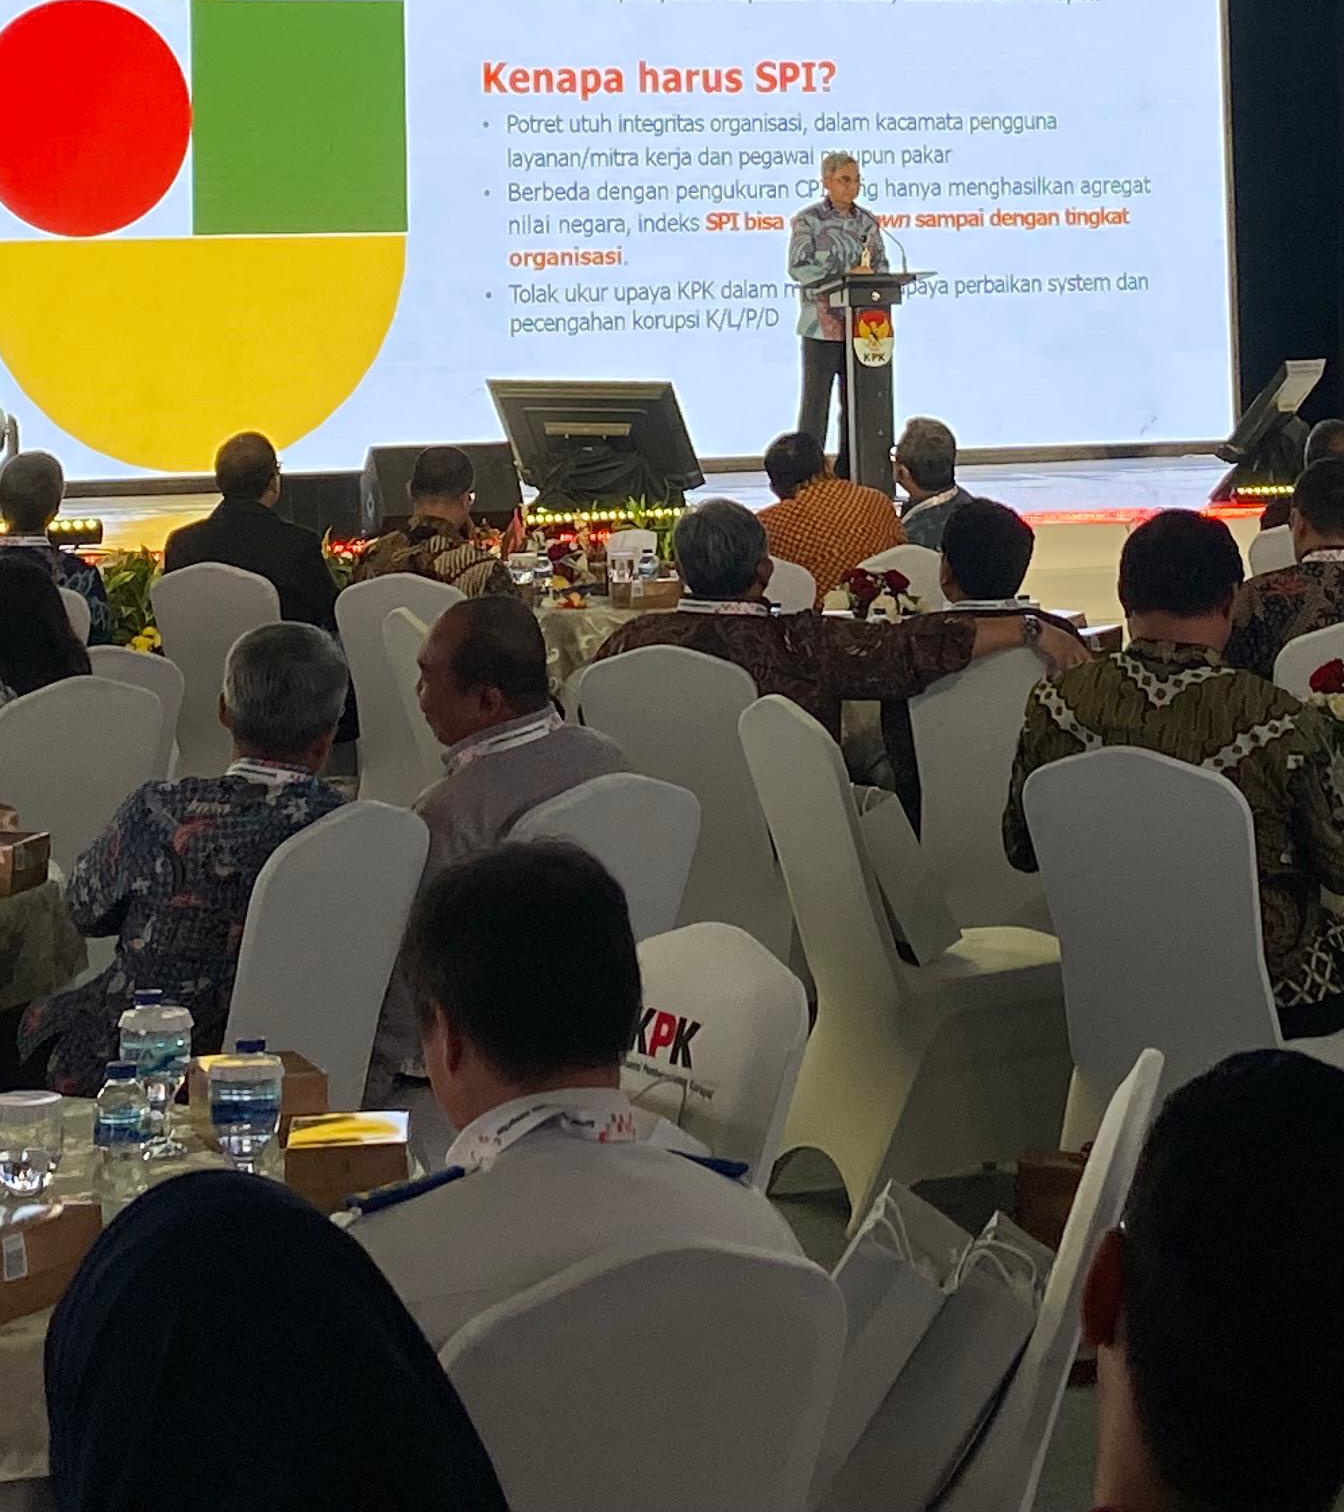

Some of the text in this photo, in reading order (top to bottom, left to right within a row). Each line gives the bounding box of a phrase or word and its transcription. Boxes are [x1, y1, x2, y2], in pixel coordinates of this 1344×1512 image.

[483, 61, 836, 101] Kenapa harus SPI?
[507, 113, 1057, 137] Potret utuh integritas organisasi, dalam kacamata pengguna
[507, 147, 639, 171] layanan/mitra
[645, 148, 692, 170] kerja
[697, 147, 733, 166] dan
[739, 146, 815, 170] pegawai
[901, 145, 952, 168] pakar
[508, 181, 590, 202] Berbeda
[596, 181, 669, 203] dengan
[676, 179, 789, 203] pengukuran
[885, 178, 939, 201] hanya
[948, 177, 1075, 201] menghasilkan
[1080, 177, 1152, 198] agregat
[508, 214, 550, 234] nilai
[559, 216, 631, 238] negara,
[638, 213, 700, 233] indeks
[705, 212, 740, 232] SPI
[744, 211, 785, 231] bisa
[915, 208, 984, 232] sampai
[989, 208, 1060, 231] dengan
[1065, 207, 1131, 229] tingkat
[509, 245, 629, 270] organisasi.
[509, 283, 558, 304] Tolak
[565, 283, 609, 303] ukur
[614, 285, 672, 306] upaya
[678, 281, 716, 300] KPK
[720, 280, 778, 300] dalam
[955, 274, 1043, 298] perbaikan
[1047, 275, 1111, 294] system
[1116, 272, 1150, 293] dan
[510, 308, 780, 337] pecengahan korupsi K/L/P/D
[863, 352, 886, 362] KPK
[632, 1007, 702, 1069] KPK
